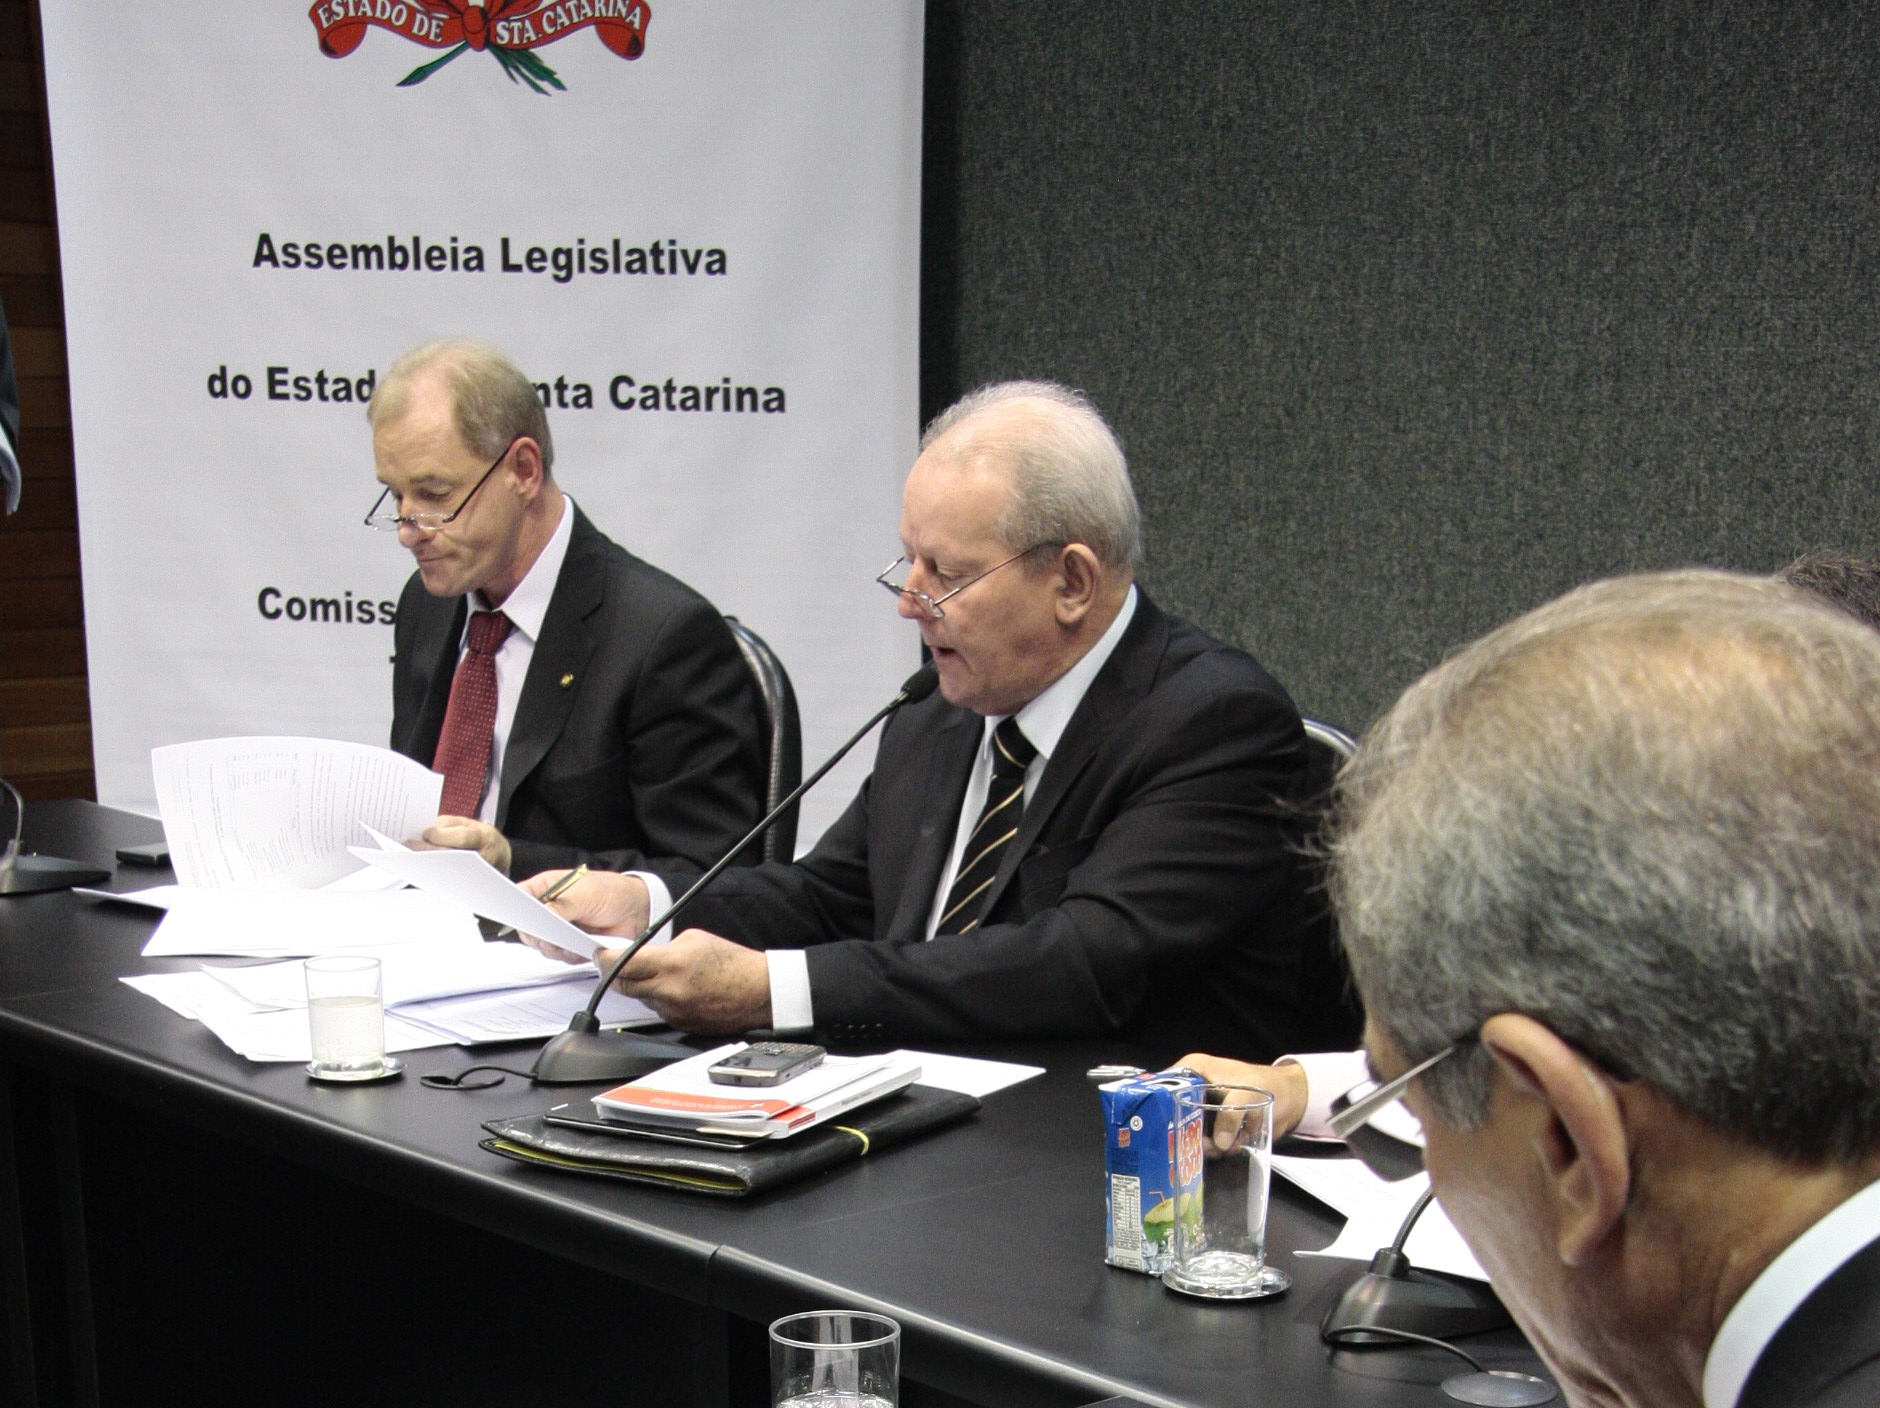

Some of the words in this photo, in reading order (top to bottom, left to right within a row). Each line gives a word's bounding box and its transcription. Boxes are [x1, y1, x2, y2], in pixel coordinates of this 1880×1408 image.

[317, 0, 408, 29] ESTADO
[411, 12, 444, 42] DE
[495, 19, 543, 45] STA.
[541, 0, 641, 35] CATARINA
[252, 232, 485, 273] Assembleia
[500, 237, 728, 284] Legislativa
[207, 365, 253, 400] do
[266, 366, 376, 403] Estad
[532, 374, 593, 410] nta
[609, 374, 786, 414] Catarina
[257, 586, 397, 626] Comiss
